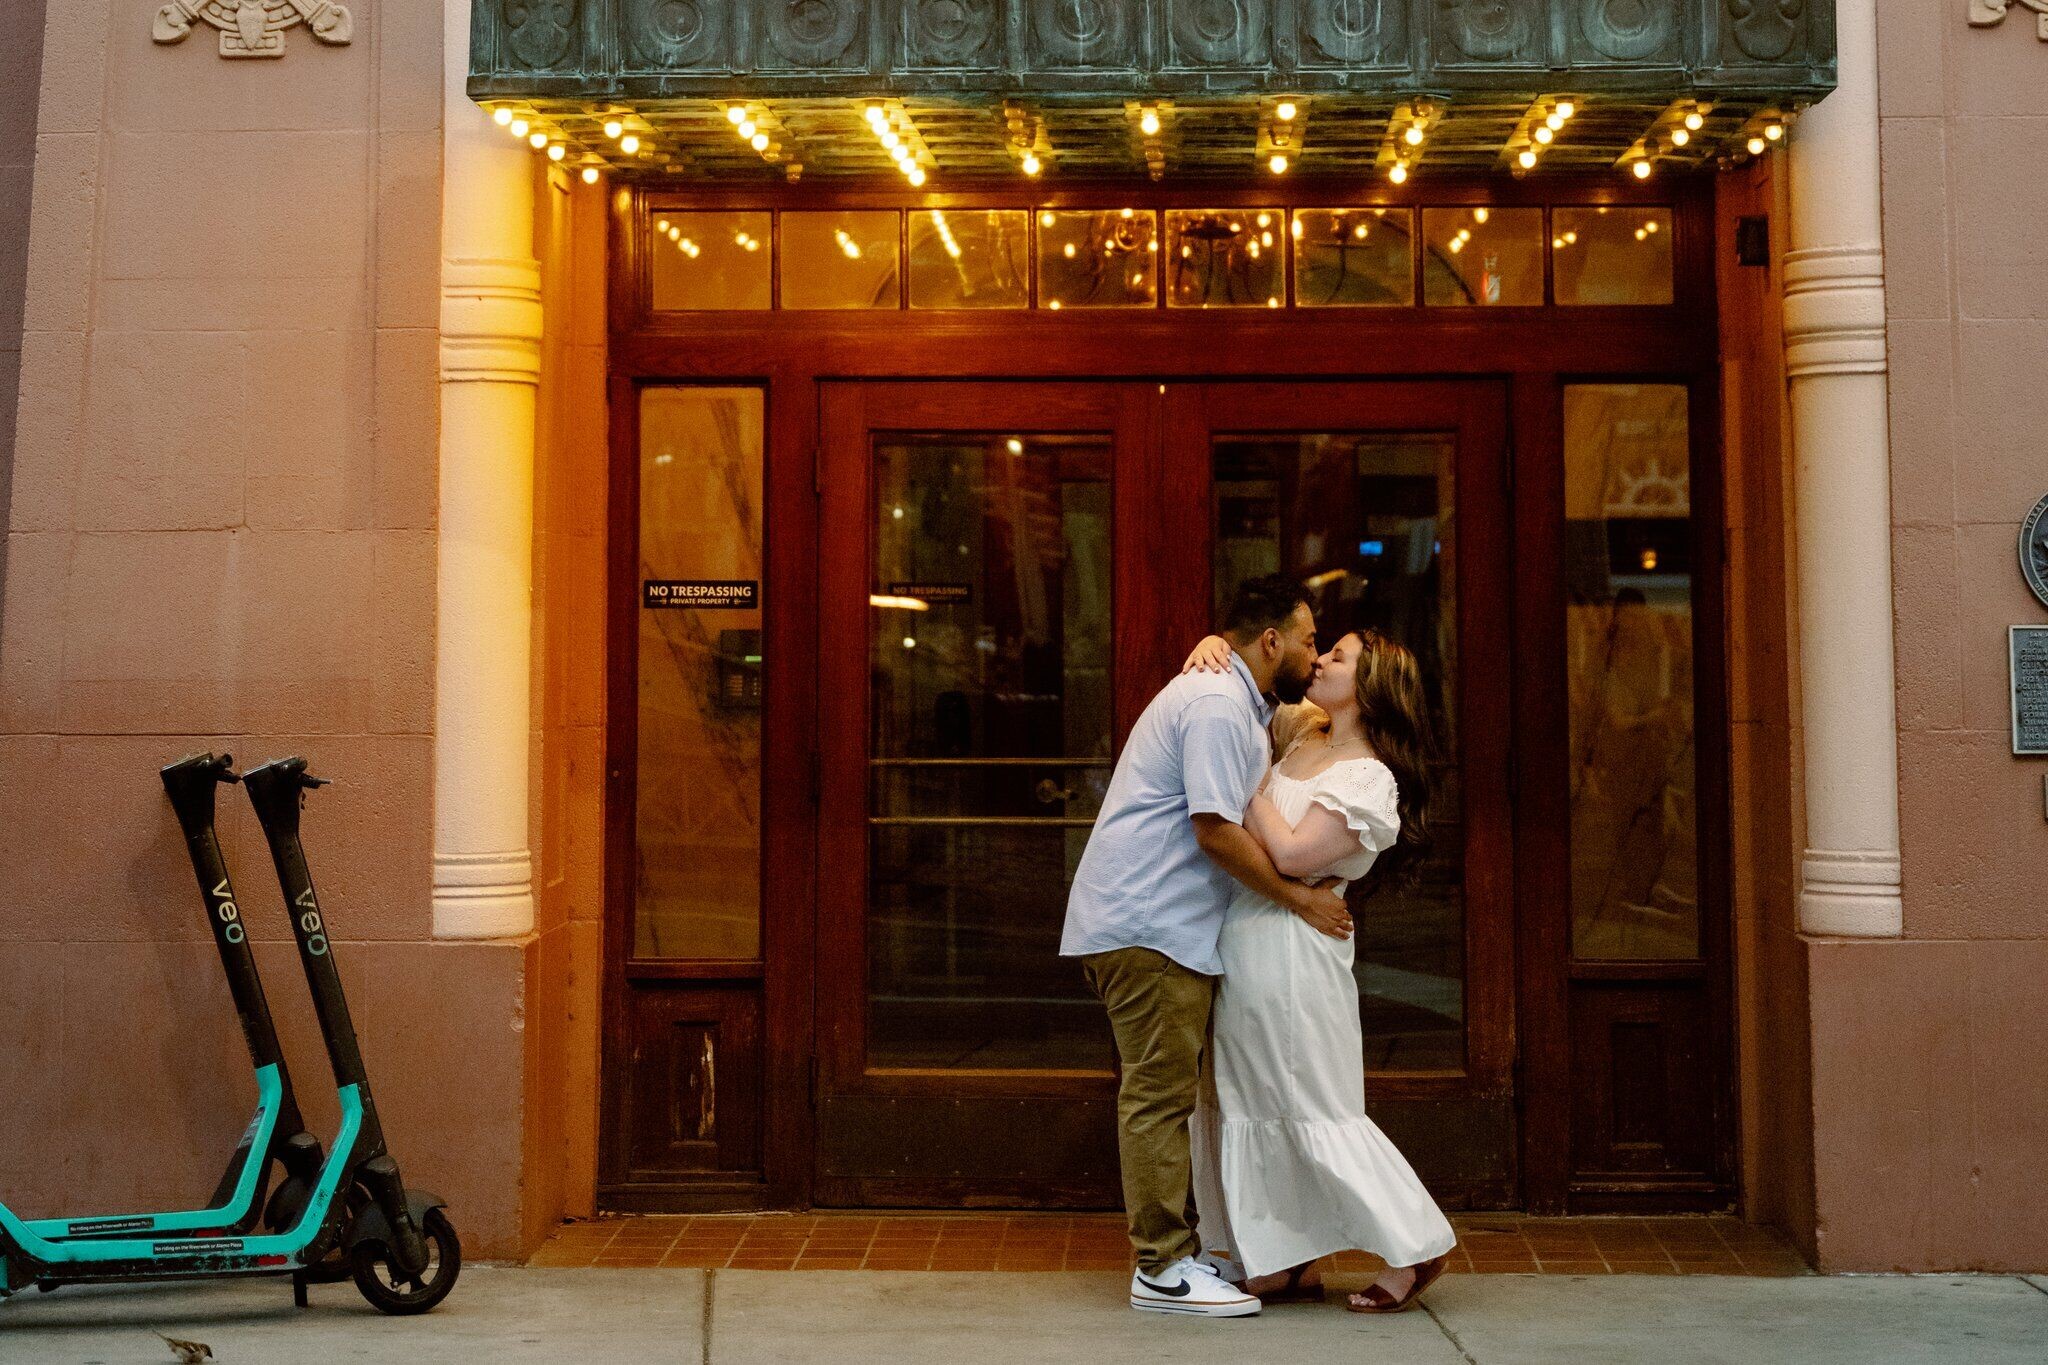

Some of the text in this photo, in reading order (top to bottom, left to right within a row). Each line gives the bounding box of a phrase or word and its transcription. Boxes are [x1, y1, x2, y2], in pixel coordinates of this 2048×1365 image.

[2025, 501, 2046, 529] TEXAS
[649, 586, 751, 597] NO TRESPASSING
[910, 587, 968, 595] TRESPASSING
[212, 878, 244, 944] veo
[295, 887, 328, 956] veo
